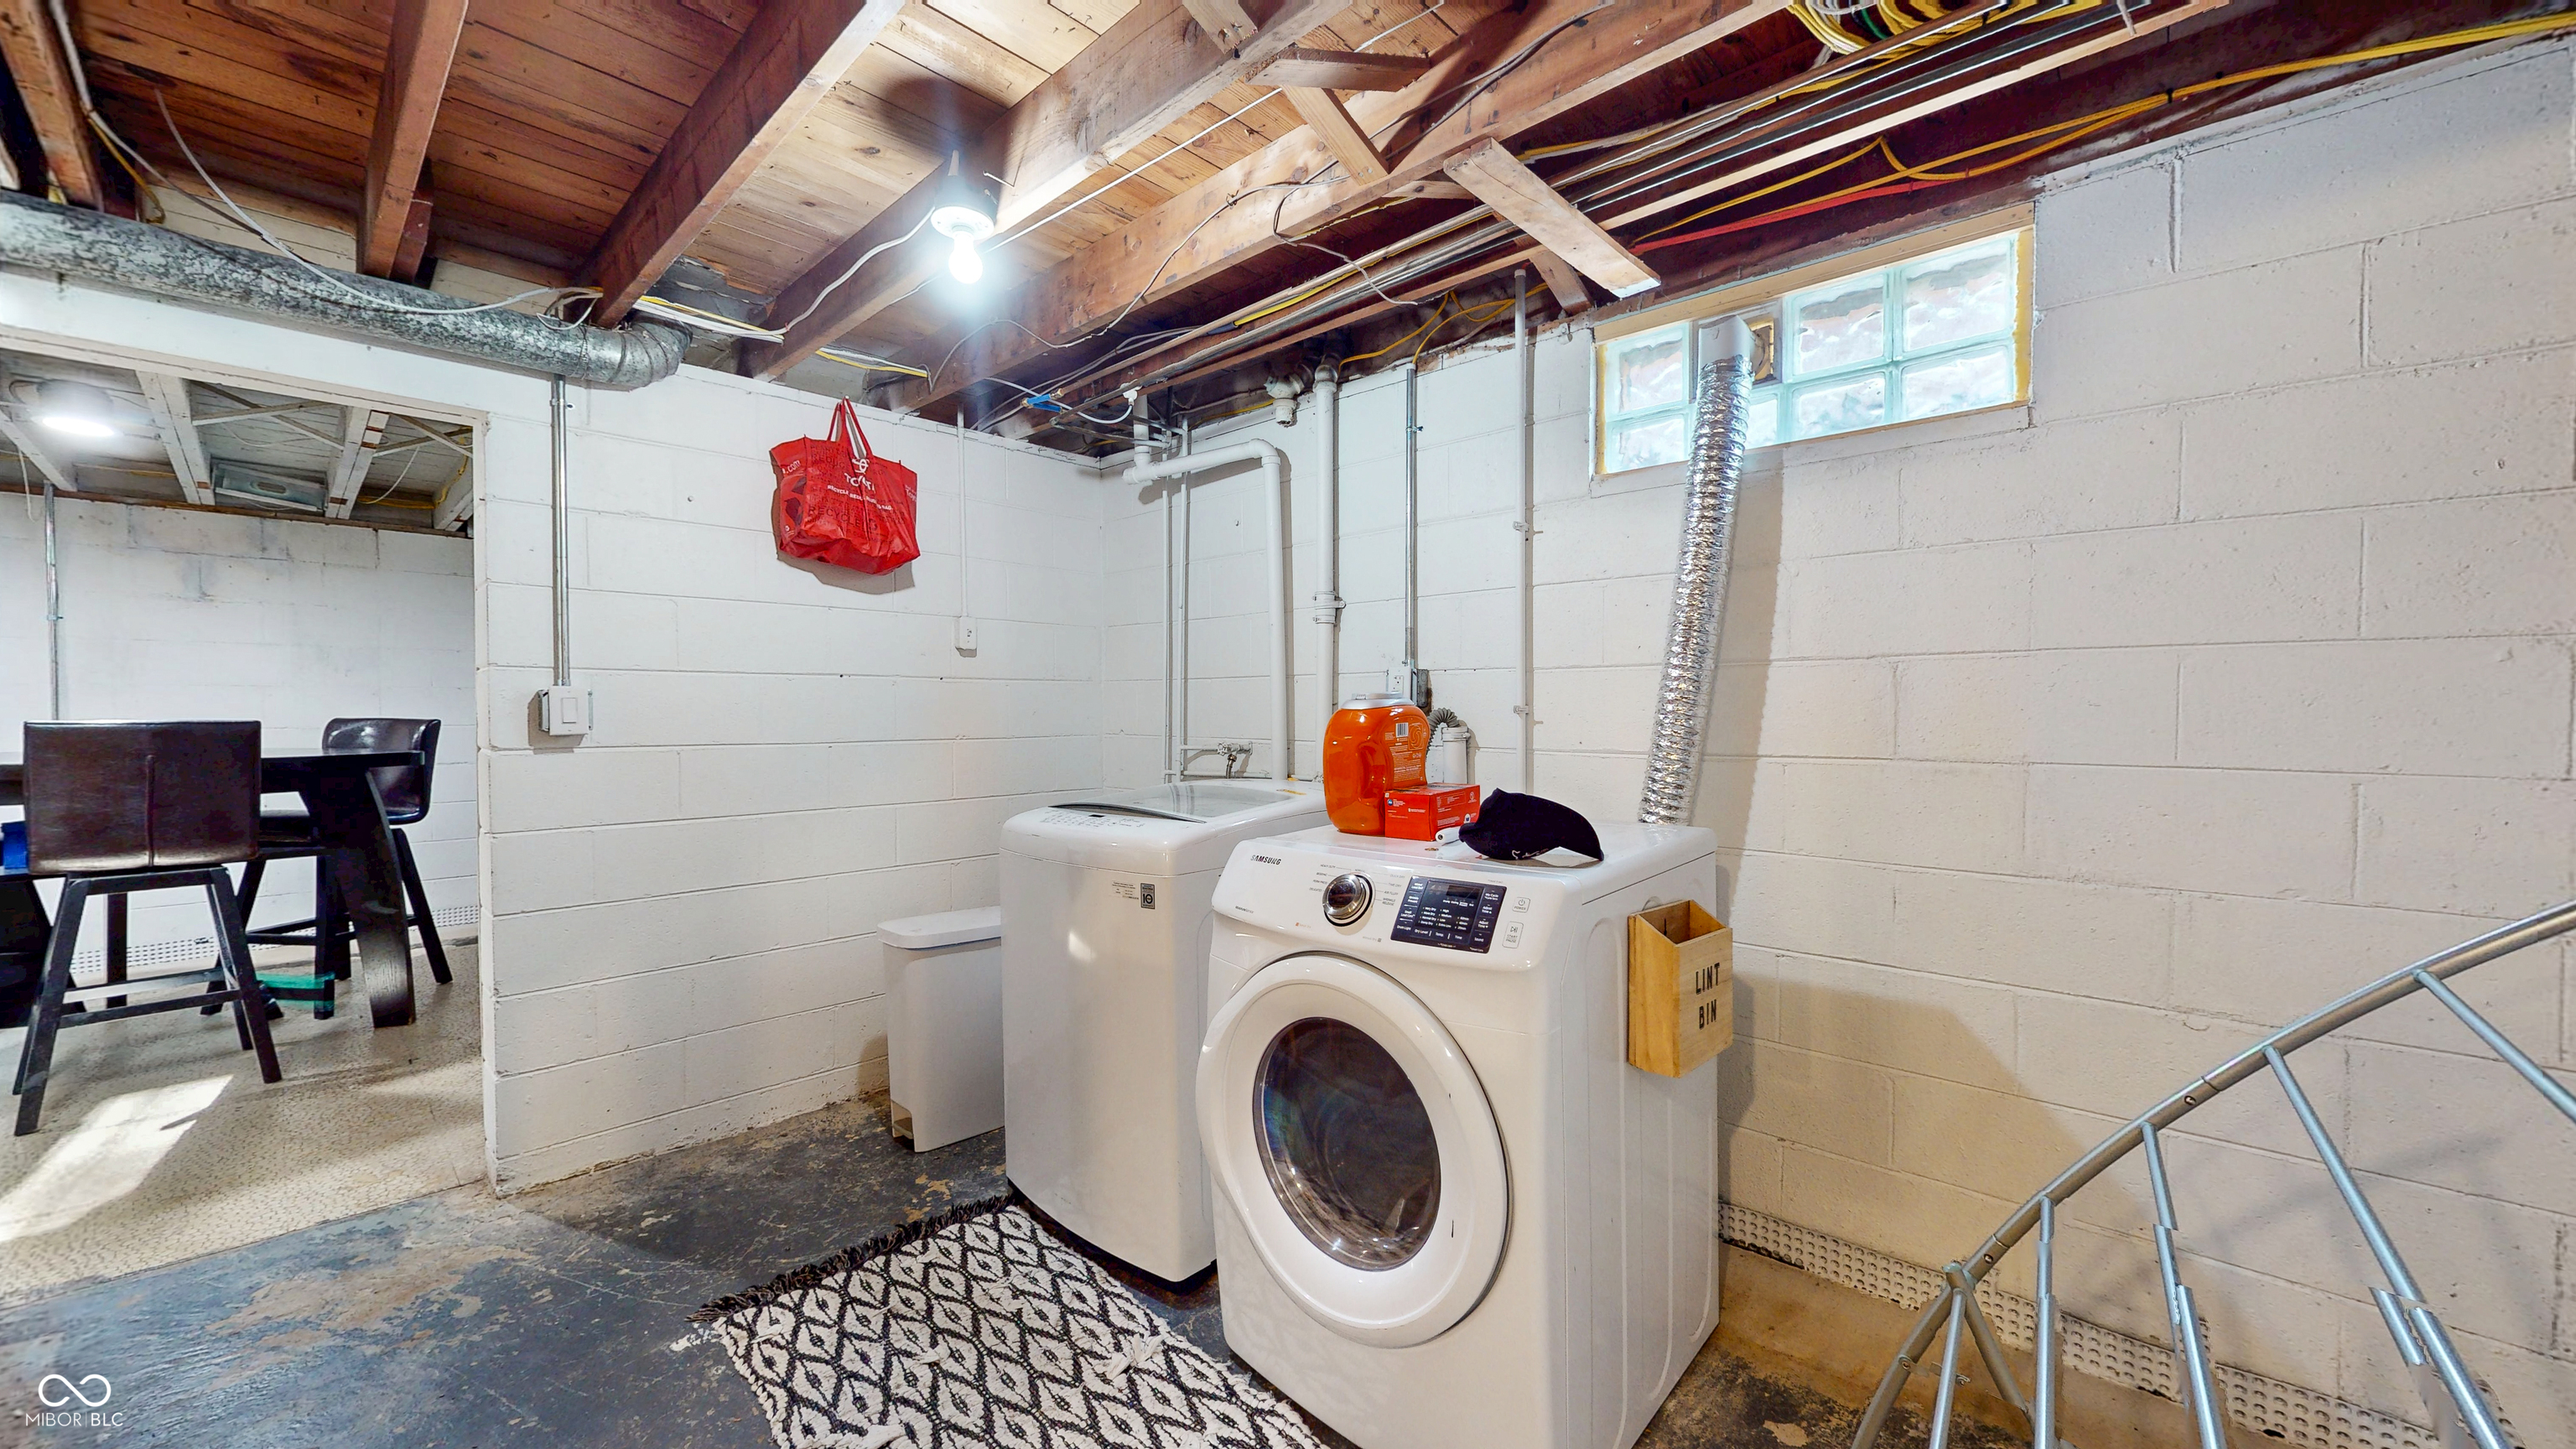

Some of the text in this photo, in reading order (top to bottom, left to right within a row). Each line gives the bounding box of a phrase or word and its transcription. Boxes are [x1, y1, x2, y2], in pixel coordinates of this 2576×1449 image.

[782, 460, 802, 474] .com
[844, 473, 875, 493] TOT
[827, 485, 849, 496] RECYCLE
[1250, 854, 1281, 865] SAMSUNG
[1142, 893, 1153, 905] 10
[1695, 962, 1720, 995] LINT
[1698, 999, 1717, 1031] BIN
